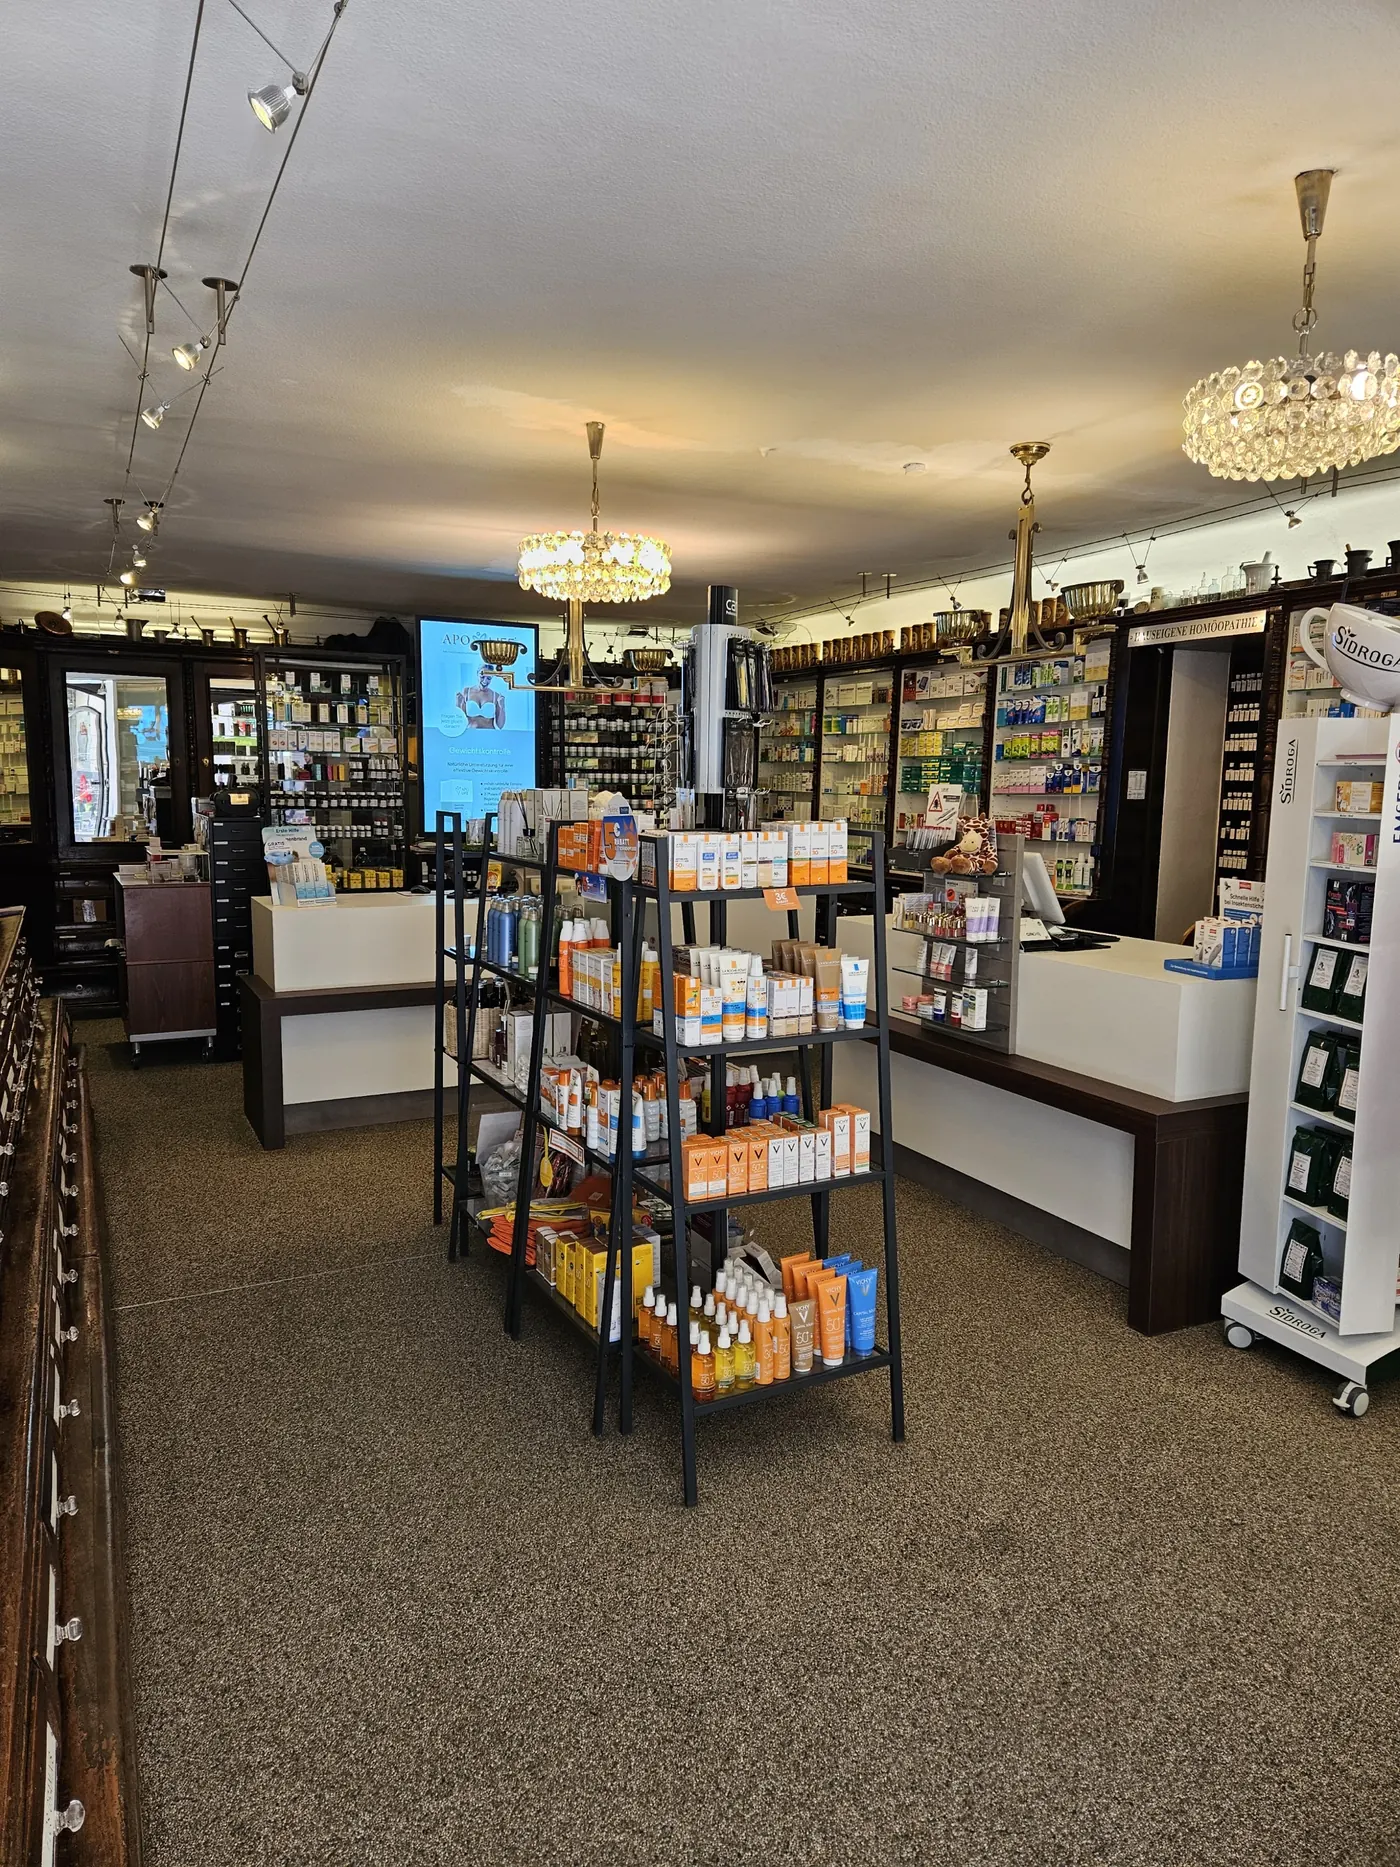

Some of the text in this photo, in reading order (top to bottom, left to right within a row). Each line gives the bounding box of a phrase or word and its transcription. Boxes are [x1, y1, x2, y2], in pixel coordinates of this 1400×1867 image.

[725, 599, 737, 612] ca
[1134, 616, 1258, 643] HAUSEIGENE HOMÖOPATHIE
[442, 633, 471, 646] APO
[448, 746, 512, 756] Gewichtskontrolle
[1280, 739, 1297, 804] SIDROGA
[775, 892, 787, 900] 3€
[1229, 893, 1260, 903] Schnelle Hilfe
[1232, 901, 1264, 910] Insektenstiche
[713, 1155, 722, 1165] V
[733, 1151, 744, 1163] V
[754, 1148, 764, 1160] V
[694, 1157, 703, 1167] V
[856, 1277, 873, 1286] VICHY
[825, 1285, 842, 1294] VICHY
[830, 1292, 840, 1307] V
[795, 1303, 810, 1312] VICHY
[799, 1311, 809, 1324] V
[1269, 1306, 1327, 1338] SIDROGA
[796, 1331, 810, 1345] 50+
